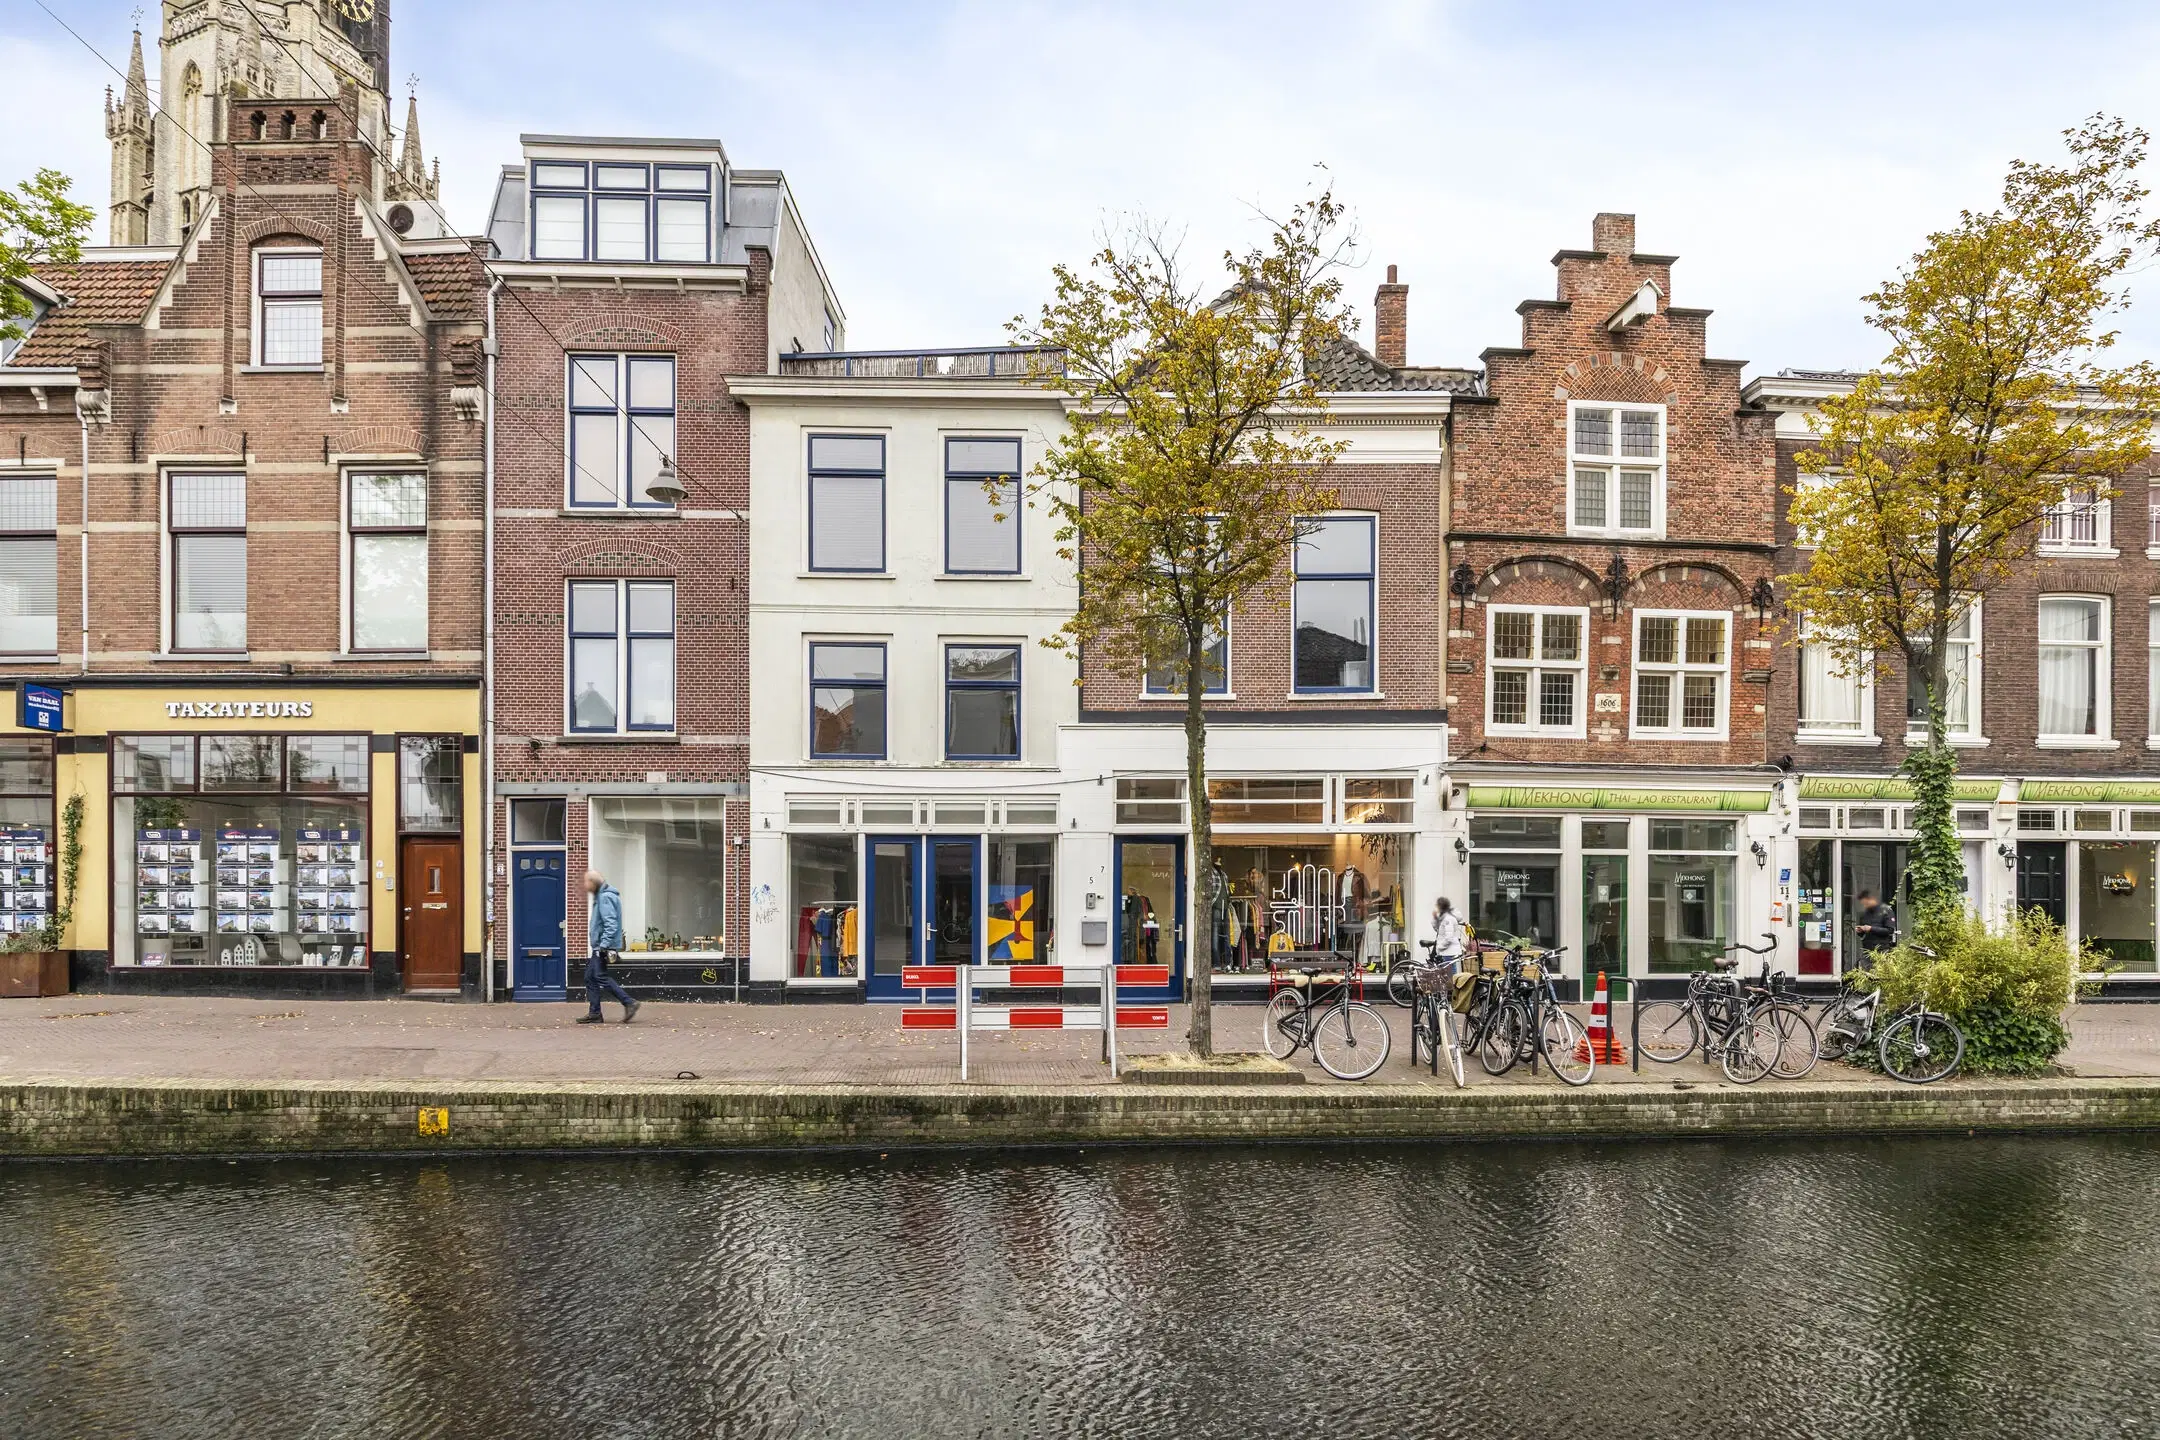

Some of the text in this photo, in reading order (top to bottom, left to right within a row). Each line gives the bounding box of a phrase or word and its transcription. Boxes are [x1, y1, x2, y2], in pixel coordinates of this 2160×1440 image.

[28, 695, 60, 706] VAN DAAL
[165, 702, 313, 718] TAXATEURS
[1802, 778, 1873, 797] MEKHONG
[2033, 781, 2103, 799] MEKHONG
[1520, 787, 1593, 806] MEKHONG
[1661, 795, 1717, 804] RESTAURANT
[1100, 865, 1105, 873] 7
[1089, 876, 1094, 884] 5
[1497, 870, 1530, 882] MEKHONG
[1780, 886, 1790, 895] 11
